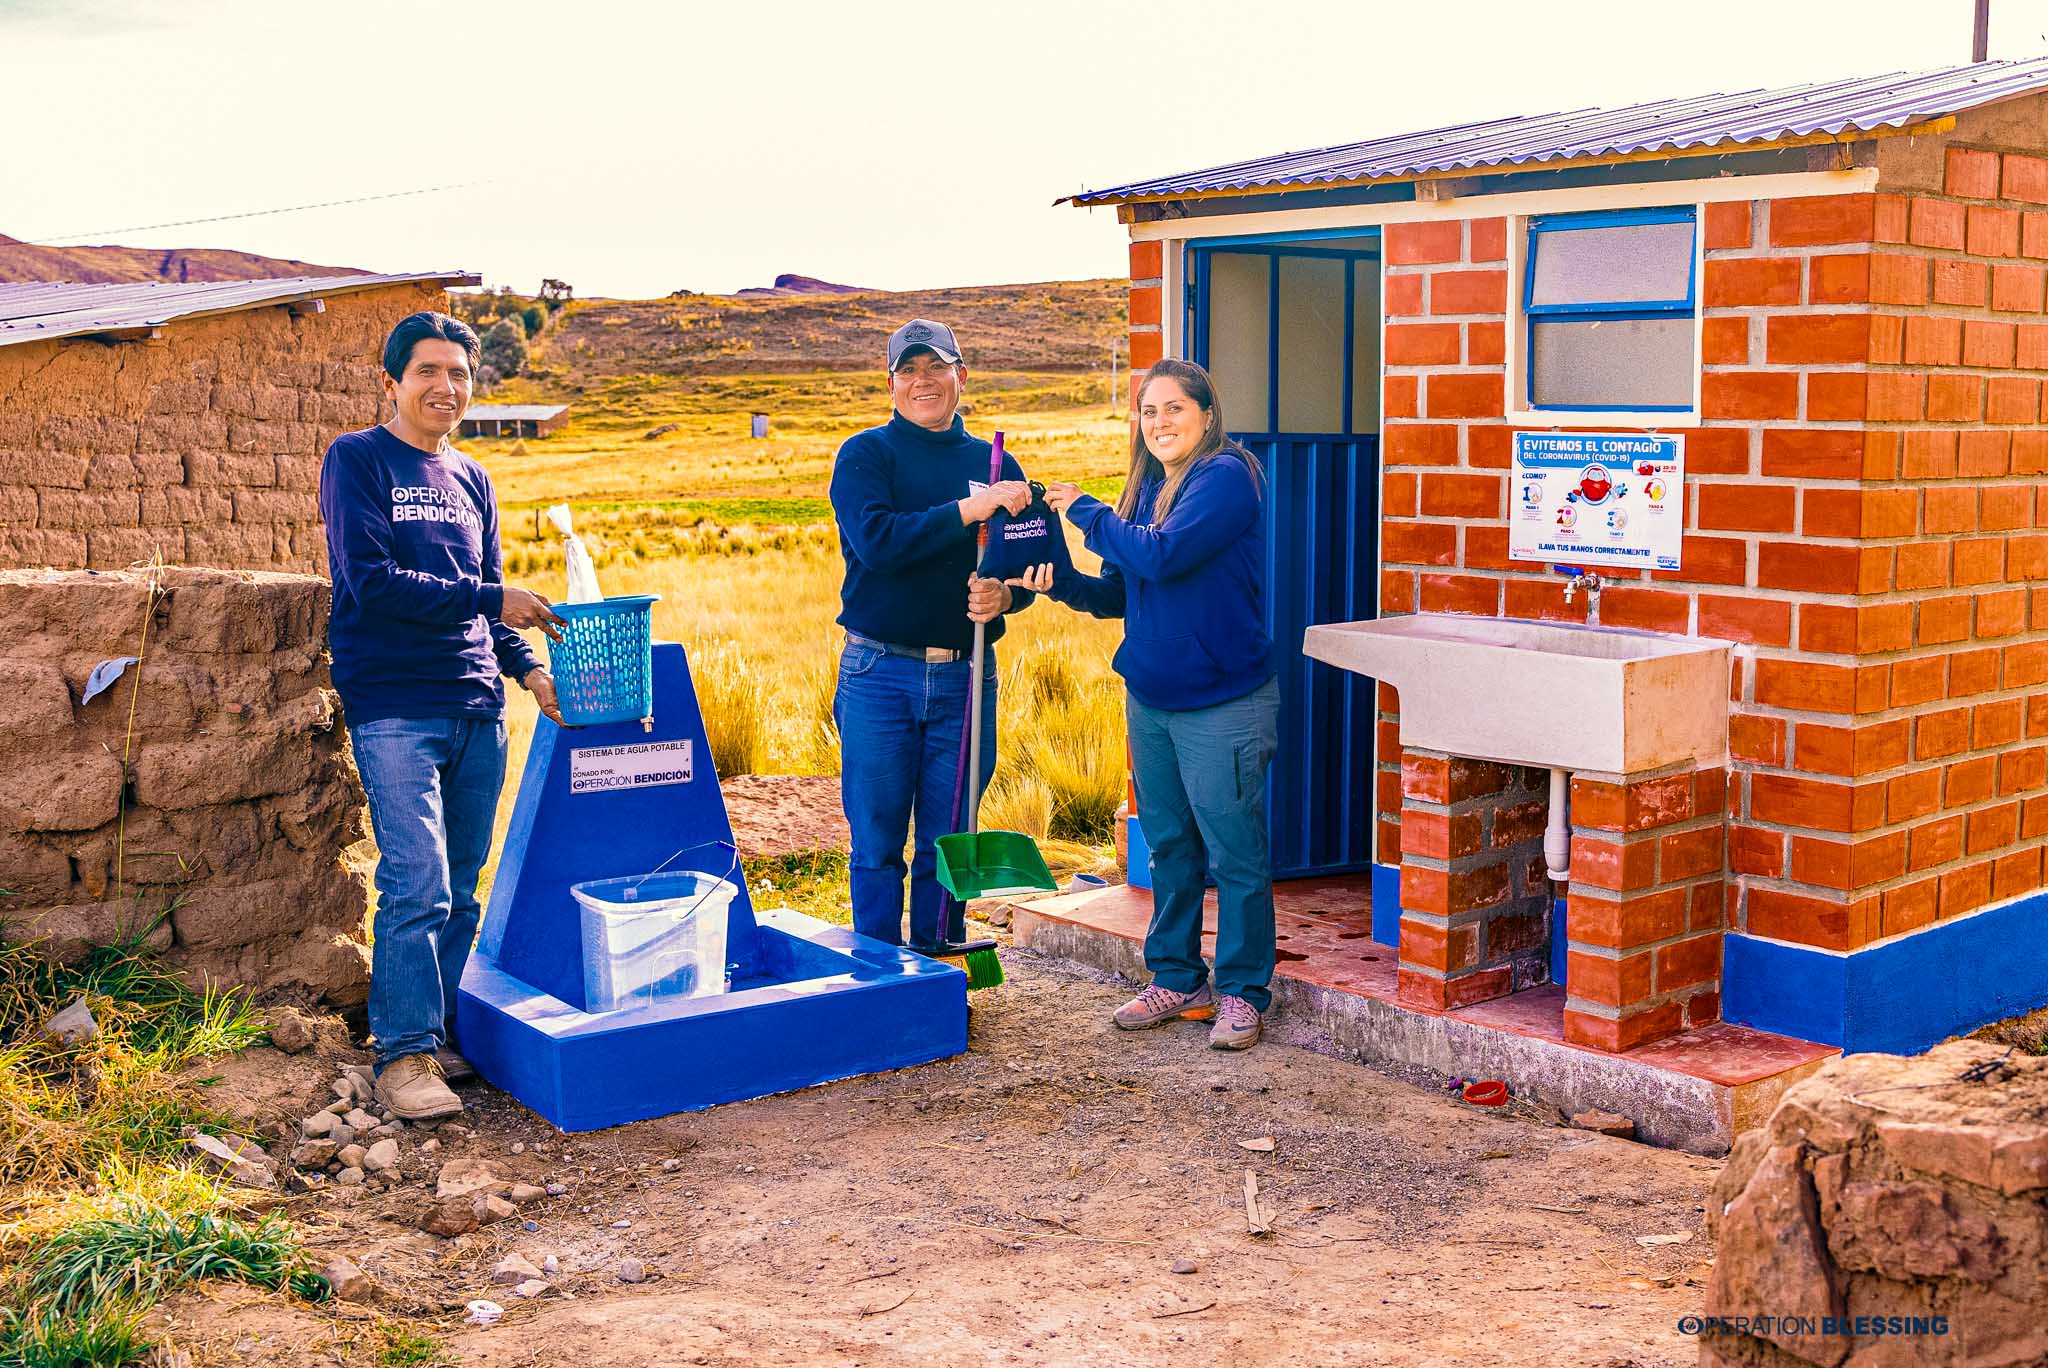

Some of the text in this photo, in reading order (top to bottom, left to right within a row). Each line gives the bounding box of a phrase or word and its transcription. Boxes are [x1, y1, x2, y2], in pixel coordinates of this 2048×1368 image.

[1523, 440, 1661, 453] EVITEMOS EL CONTAGIO
[1539, 453, 1590, 461] CORONAVIRUS
[1592, 453, 1630, 463] (COVID-19)
[1004, 516, 1046, 531] OPERACIÓN
[1004, 527, 1048, 540] BENDICIÓN
[1557, 544, 1569, 552] TUS
[1570, 545, 1594, 554] MANOS
[1594, 546, 1651, 557] CORRECTAMENTE!
[578, 742, 685, 759] SISTEMA DE AGUA POTABLE
[572, 768, 615, 778] DONADO POR:
[573, 770, 690, 789] OPERACIÓN BENDICIÓN
